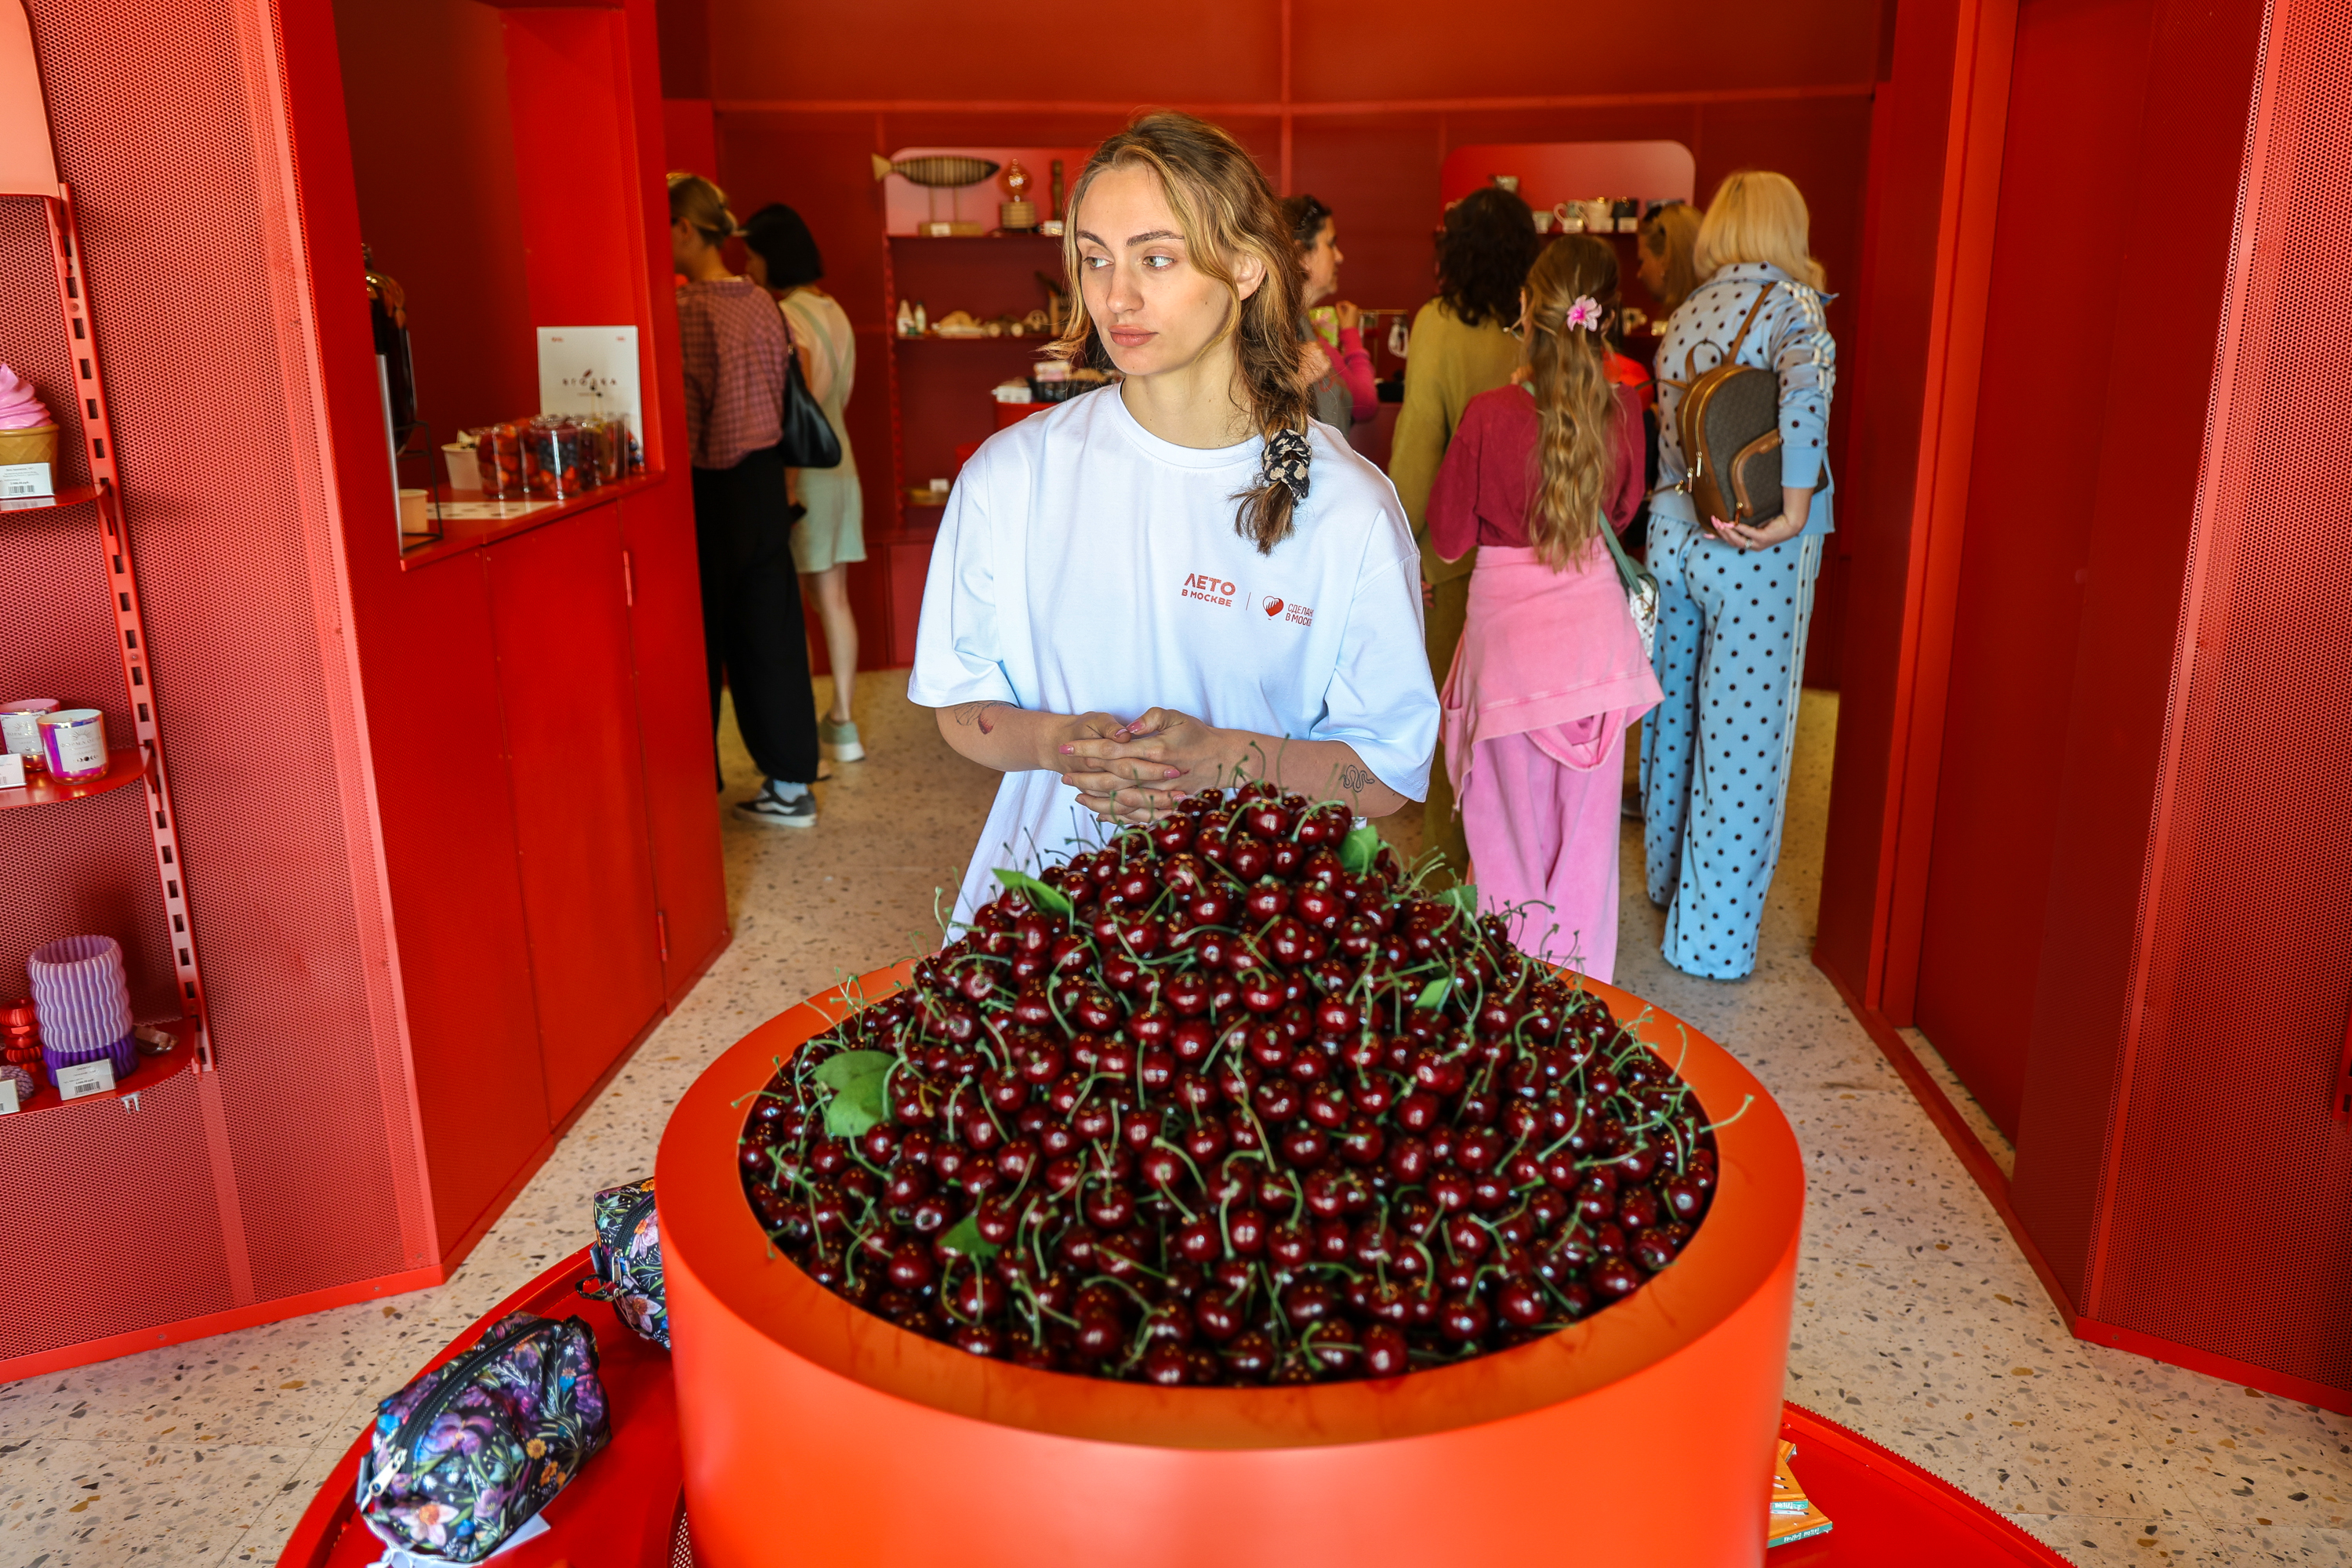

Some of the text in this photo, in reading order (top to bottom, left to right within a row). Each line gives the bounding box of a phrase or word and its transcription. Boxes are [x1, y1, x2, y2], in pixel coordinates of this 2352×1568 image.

[1184, 572, 1236, 596] ЛЕТО
[1190, 591, 1233, 607] МОСКВЕ
[1285, 612, 1291, 621] В
